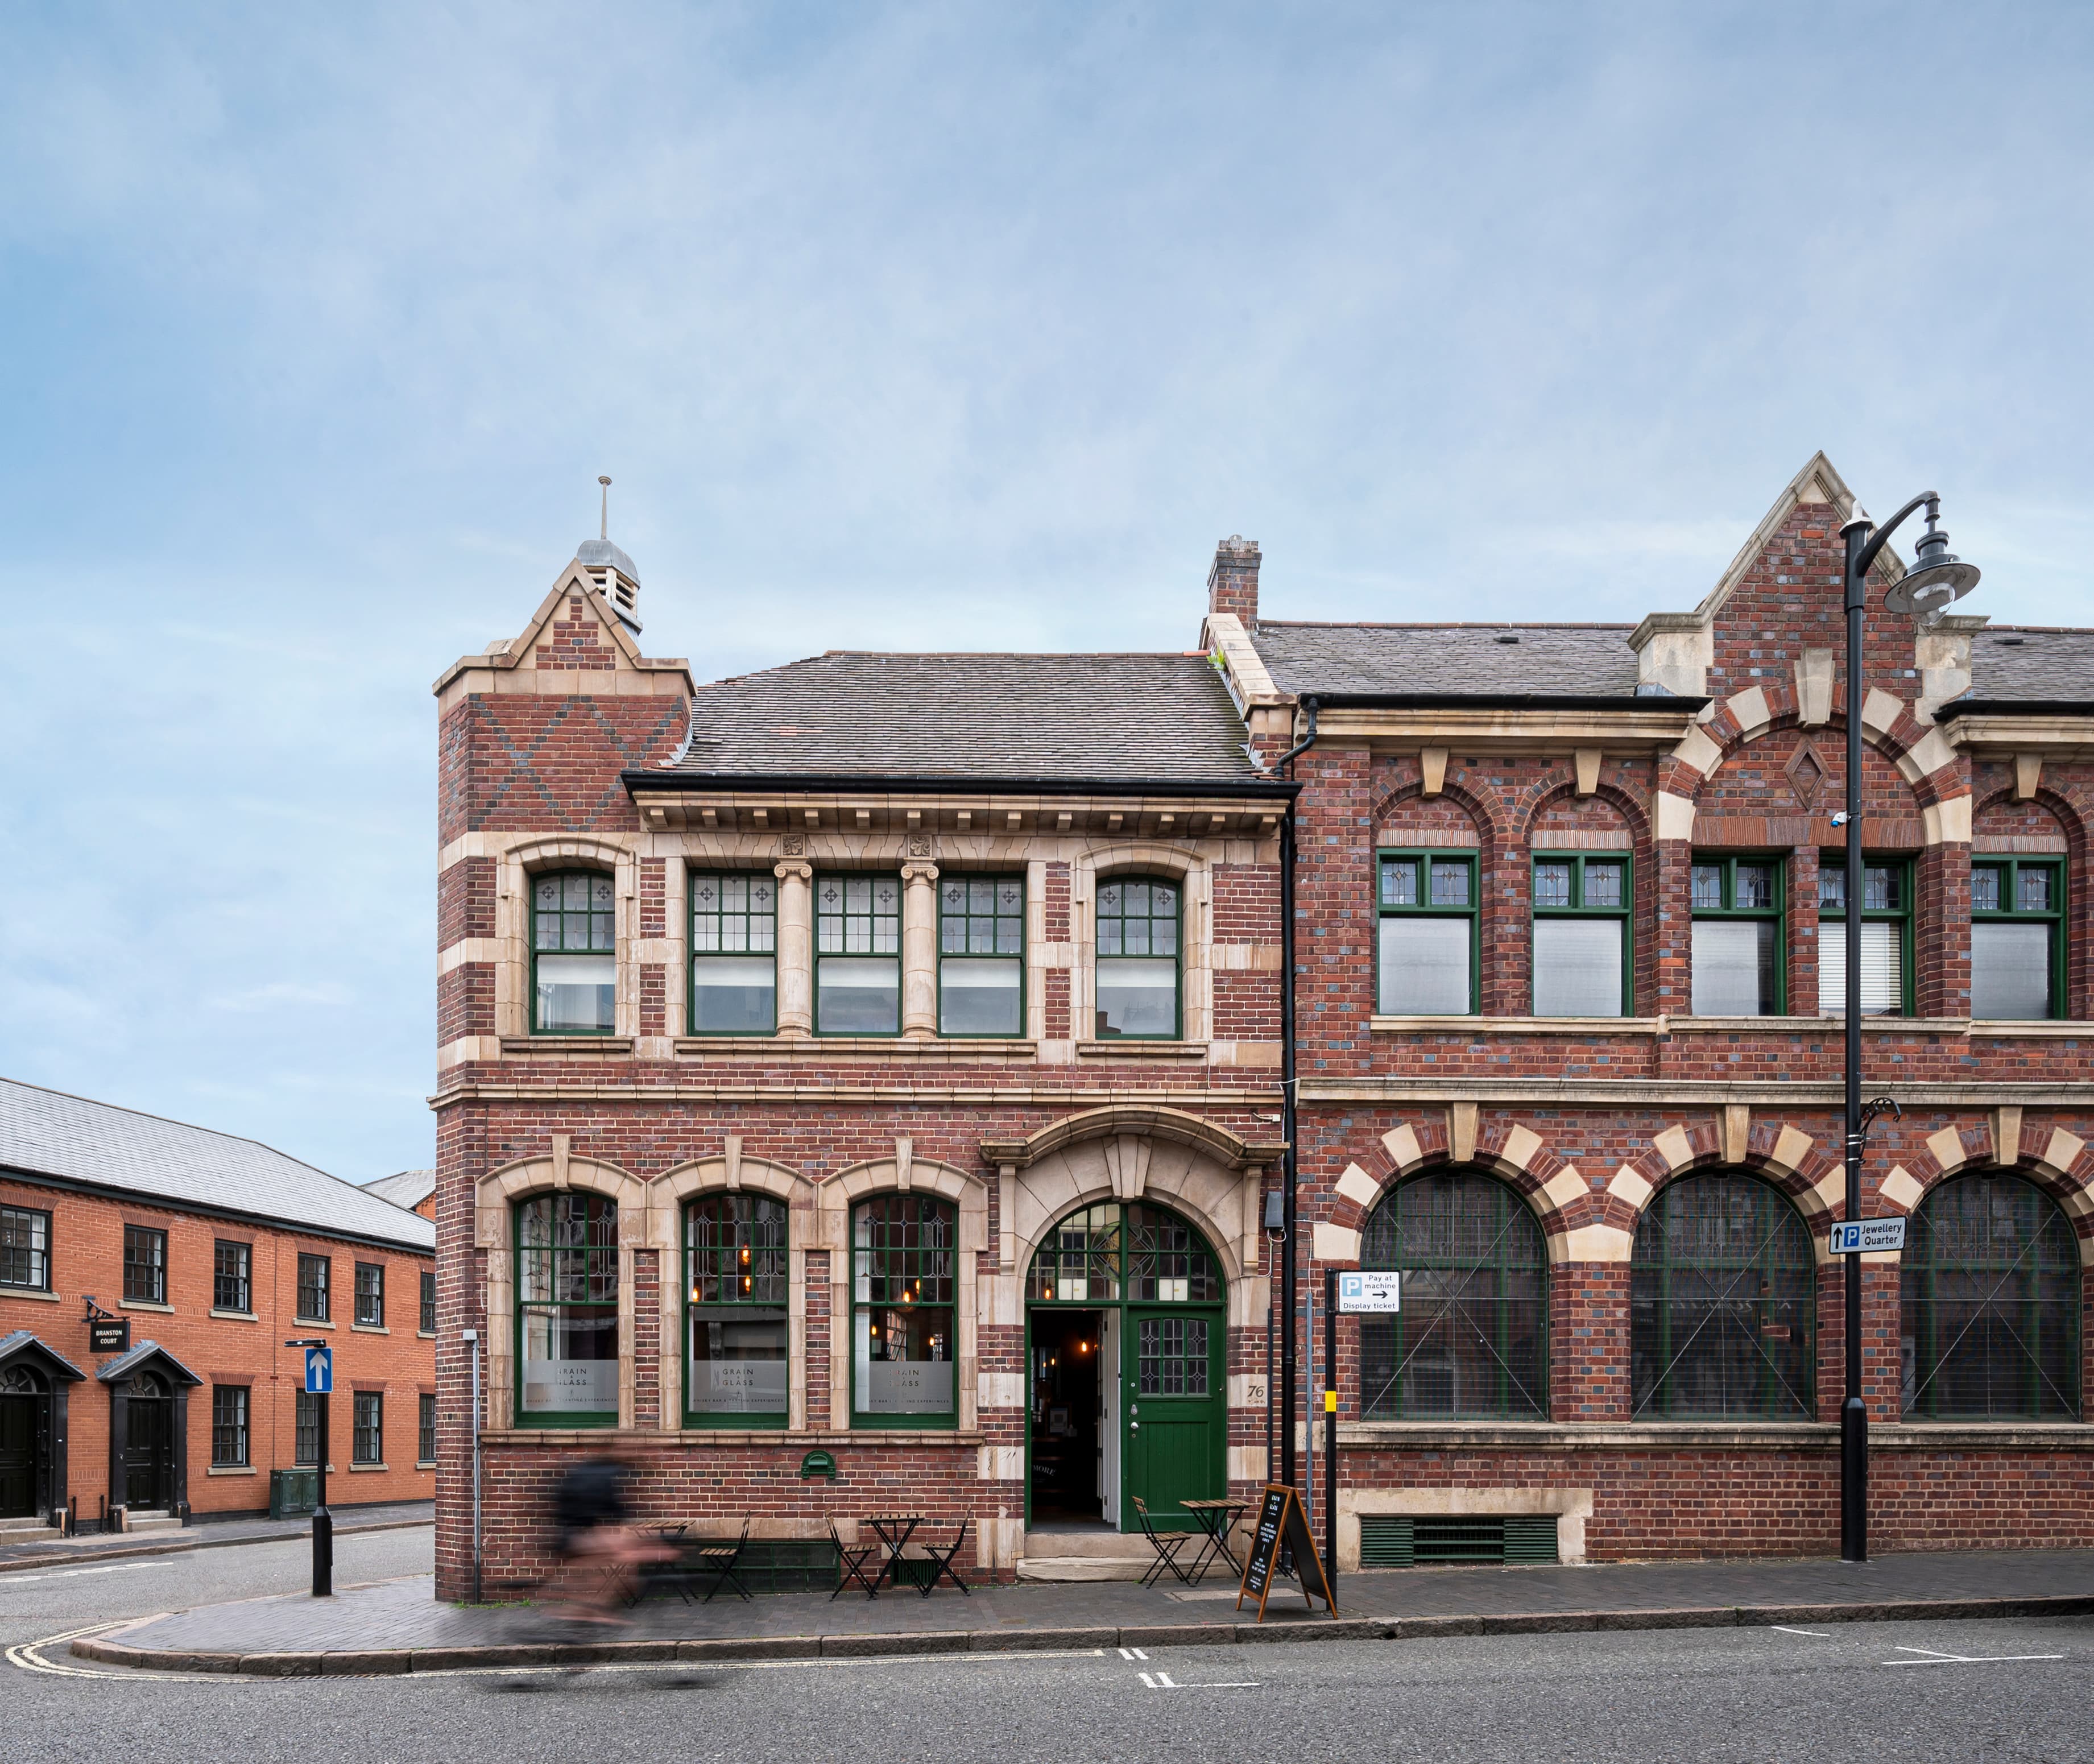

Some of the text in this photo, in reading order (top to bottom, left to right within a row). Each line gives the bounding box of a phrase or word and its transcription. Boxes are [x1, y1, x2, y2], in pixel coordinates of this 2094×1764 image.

[1847, 1223, 1902, 1245] P Jewellery
[1864, 1236, 1898, 1245] Quarter
[1346, 1278, 1360, 1295] P
[1247, 1385, 1265, 1397] 76
